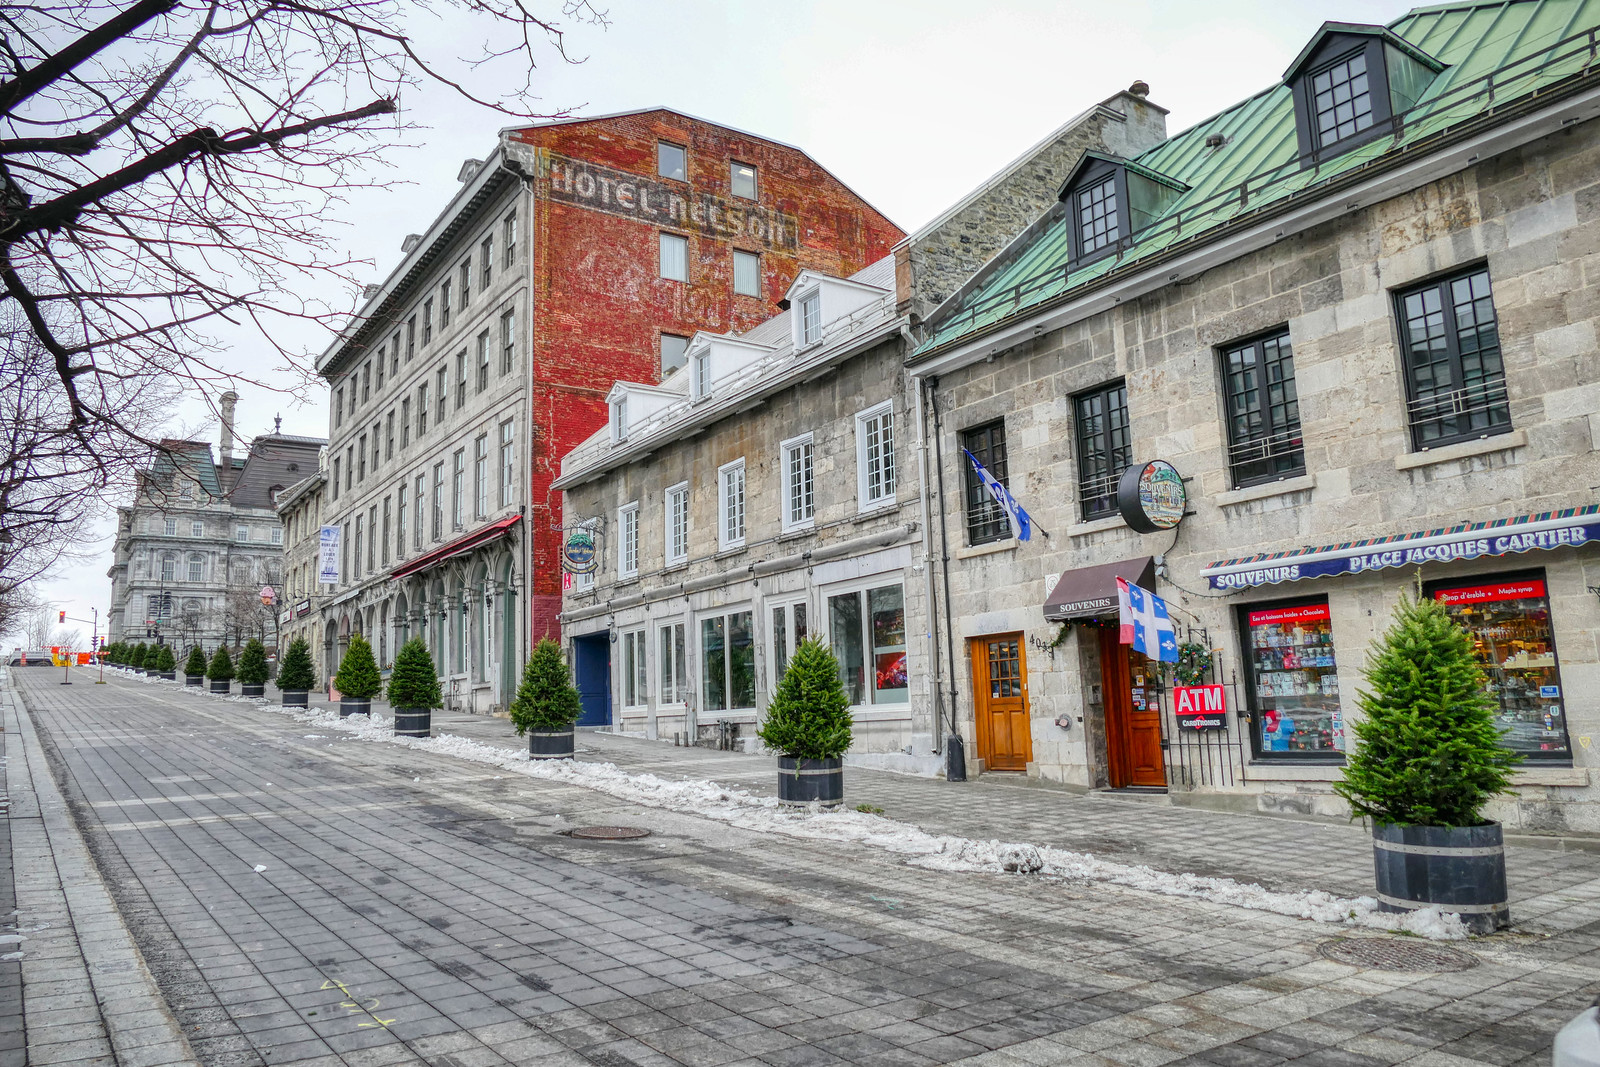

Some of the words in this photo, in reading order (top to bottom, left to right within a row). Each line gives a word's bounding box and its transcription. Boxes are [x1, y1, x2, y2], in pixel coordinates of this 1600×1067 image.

[1139, 482, 1183, 495] SOUVENIRS
[1216, 565, 1300, 587] SOUVENIRS
[1349, 550, 1402, 570] PLACE
[1405, 539, 1490, 562] JACQUES
[1495, 526, 1587, 551] CARTIER
[1460, 590, 1486, 600] d'érable
[1498, 587, 1517, 595] Maple
[1518, 586, 1533, 594] syrup
[1060, 598, 1111, 612] SOUVENIRS
[1303, 608, 1325, 616] Chocolats
[1177, 687, 1223, 712] ATM
